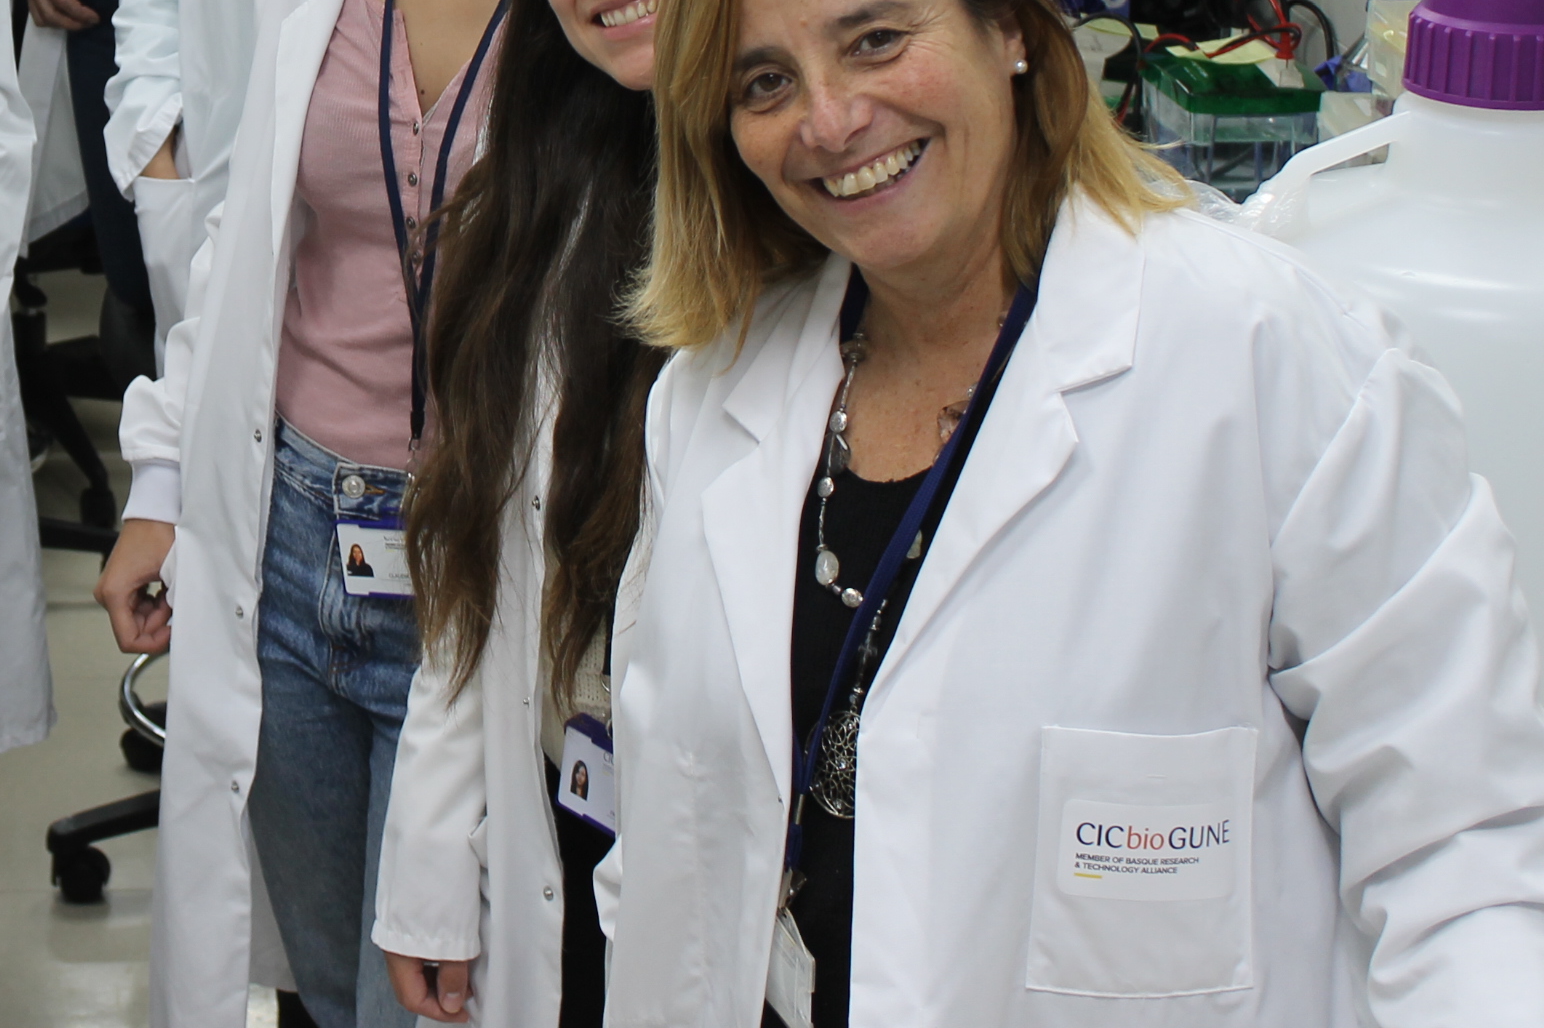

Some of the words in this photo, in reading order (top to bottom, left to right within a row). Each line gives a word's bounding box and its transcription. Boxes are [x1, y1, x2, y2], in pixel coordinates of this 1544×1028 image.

[1075, 852, 1111, 863] MEMBER
[1112, 856, 1124, 865] OF
[1125, 857, 1159, 866] BASQUE
[1160, 856, 1200, 866] RESEARCH
[1074, 861, 1081, 869] &
[1083, 862, 1139, 874] TECHNOLOGY
[1141, 865, 1178, 875] ALLIANCE
